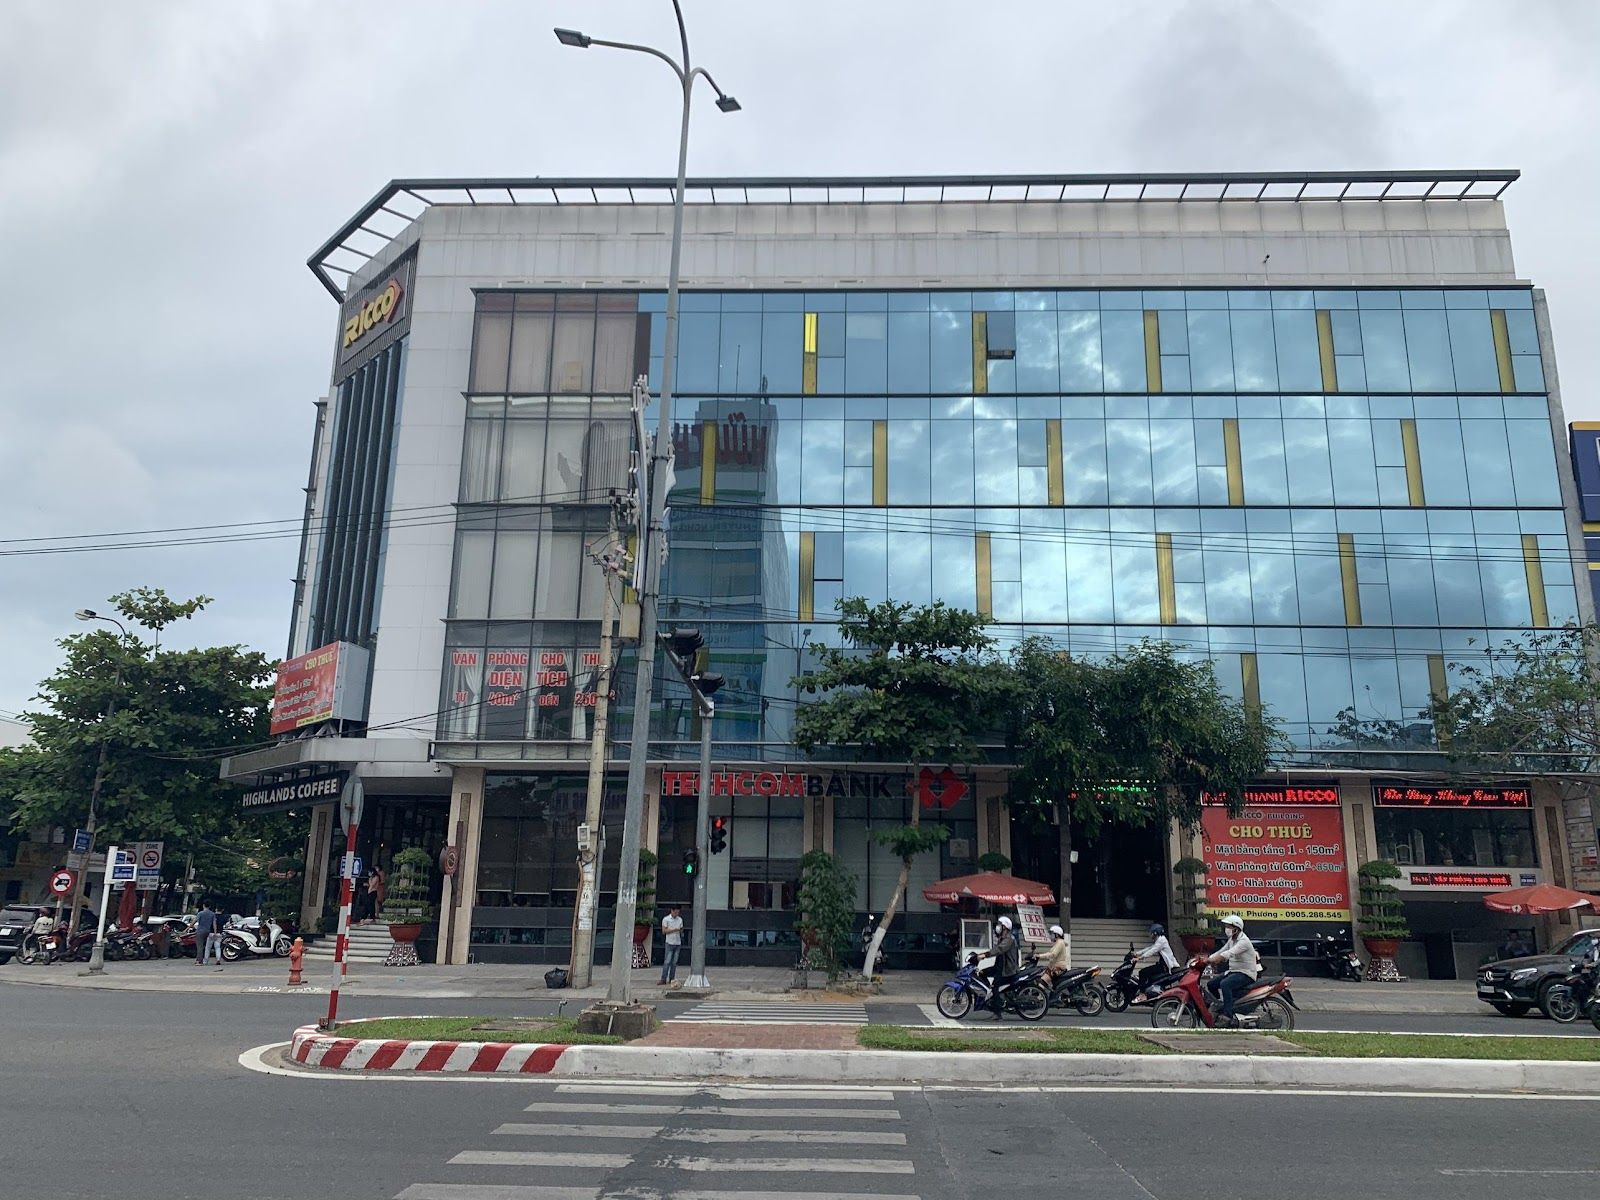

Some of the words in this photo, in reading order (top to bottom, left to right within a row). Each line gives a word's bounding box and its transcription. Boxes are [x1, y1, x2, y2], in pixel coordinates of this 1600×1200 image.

[541, 652, 565, 666] CHO
[489, 668, 523, 689] DIỆN
[536, 668, 568, 687] TÍCH
[663, 771, 892, 797] TEHCOMBANK
[242, 786, 296, 807] HIGHLANDS
[297, 778, 338, 799] COFFEE
[1286, 788, 1336, 802] RICCO
[1267, 812, 1304, 820] BUILDING
[1229, 825, 1264, 839] CHO
[1267, 823, 1313, 839] THUÊ
[1215, 845, 1234, 856] Mặt
[1236, 843, 1260, 856] bằng
[1288, 844, 1296, 855] 1
[1215, 861, 1235, 872] Văn
[1237, 861, 1267, 874] phòng
[1216, 878, 1236, 888] Kho
[1244, 878, 1264, 888] Nhà
[1218, 893, 1230, 904] từ
[1279, 893, 1297, 905] đến
[1247, 910, 1278, 919] Phương
[1285, 911, 1342, 919] 0905.288.545
